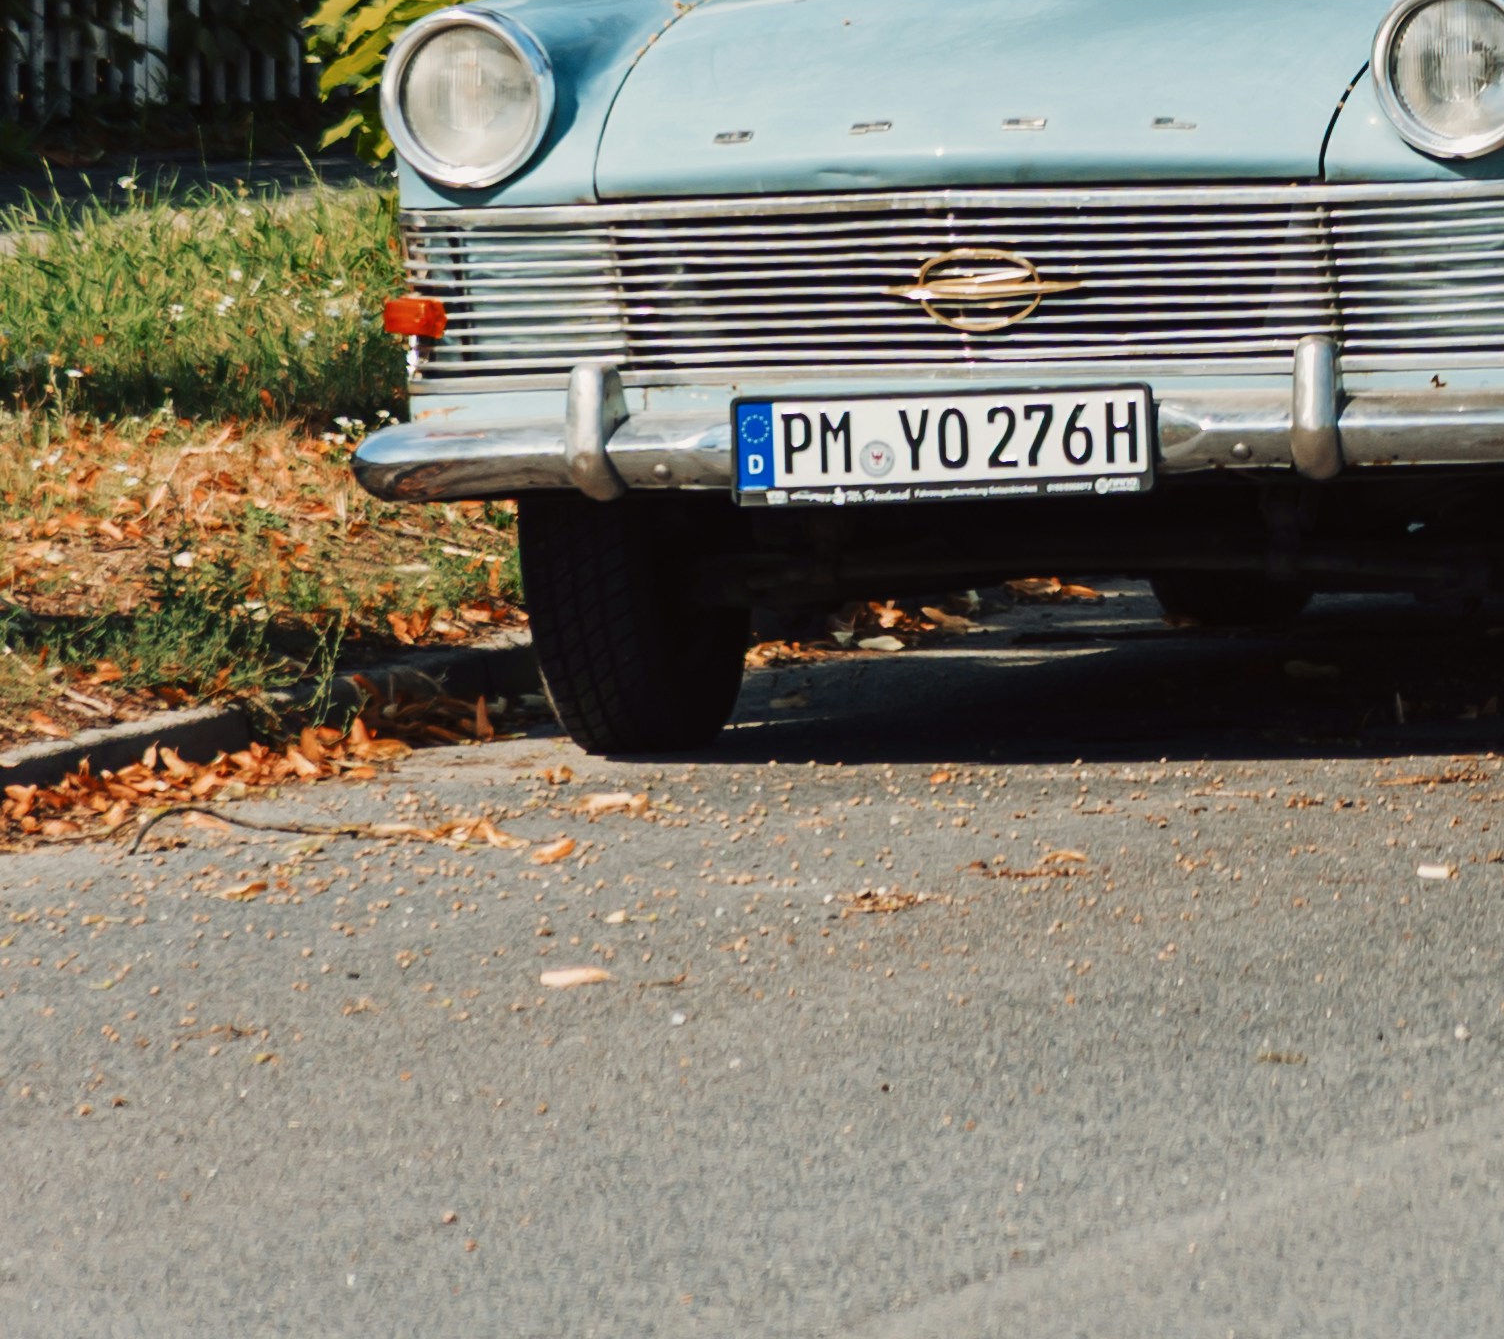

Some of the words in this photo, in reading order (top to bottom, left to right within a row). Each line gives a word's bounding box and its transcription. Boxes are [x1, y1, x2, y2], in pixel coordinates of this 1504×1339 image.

[780, 407, 853, 475] PM
[897, 403, 970, 472] YO
[986, 397, 1139, 469] 276H
[748, 454, 764, 475] D
